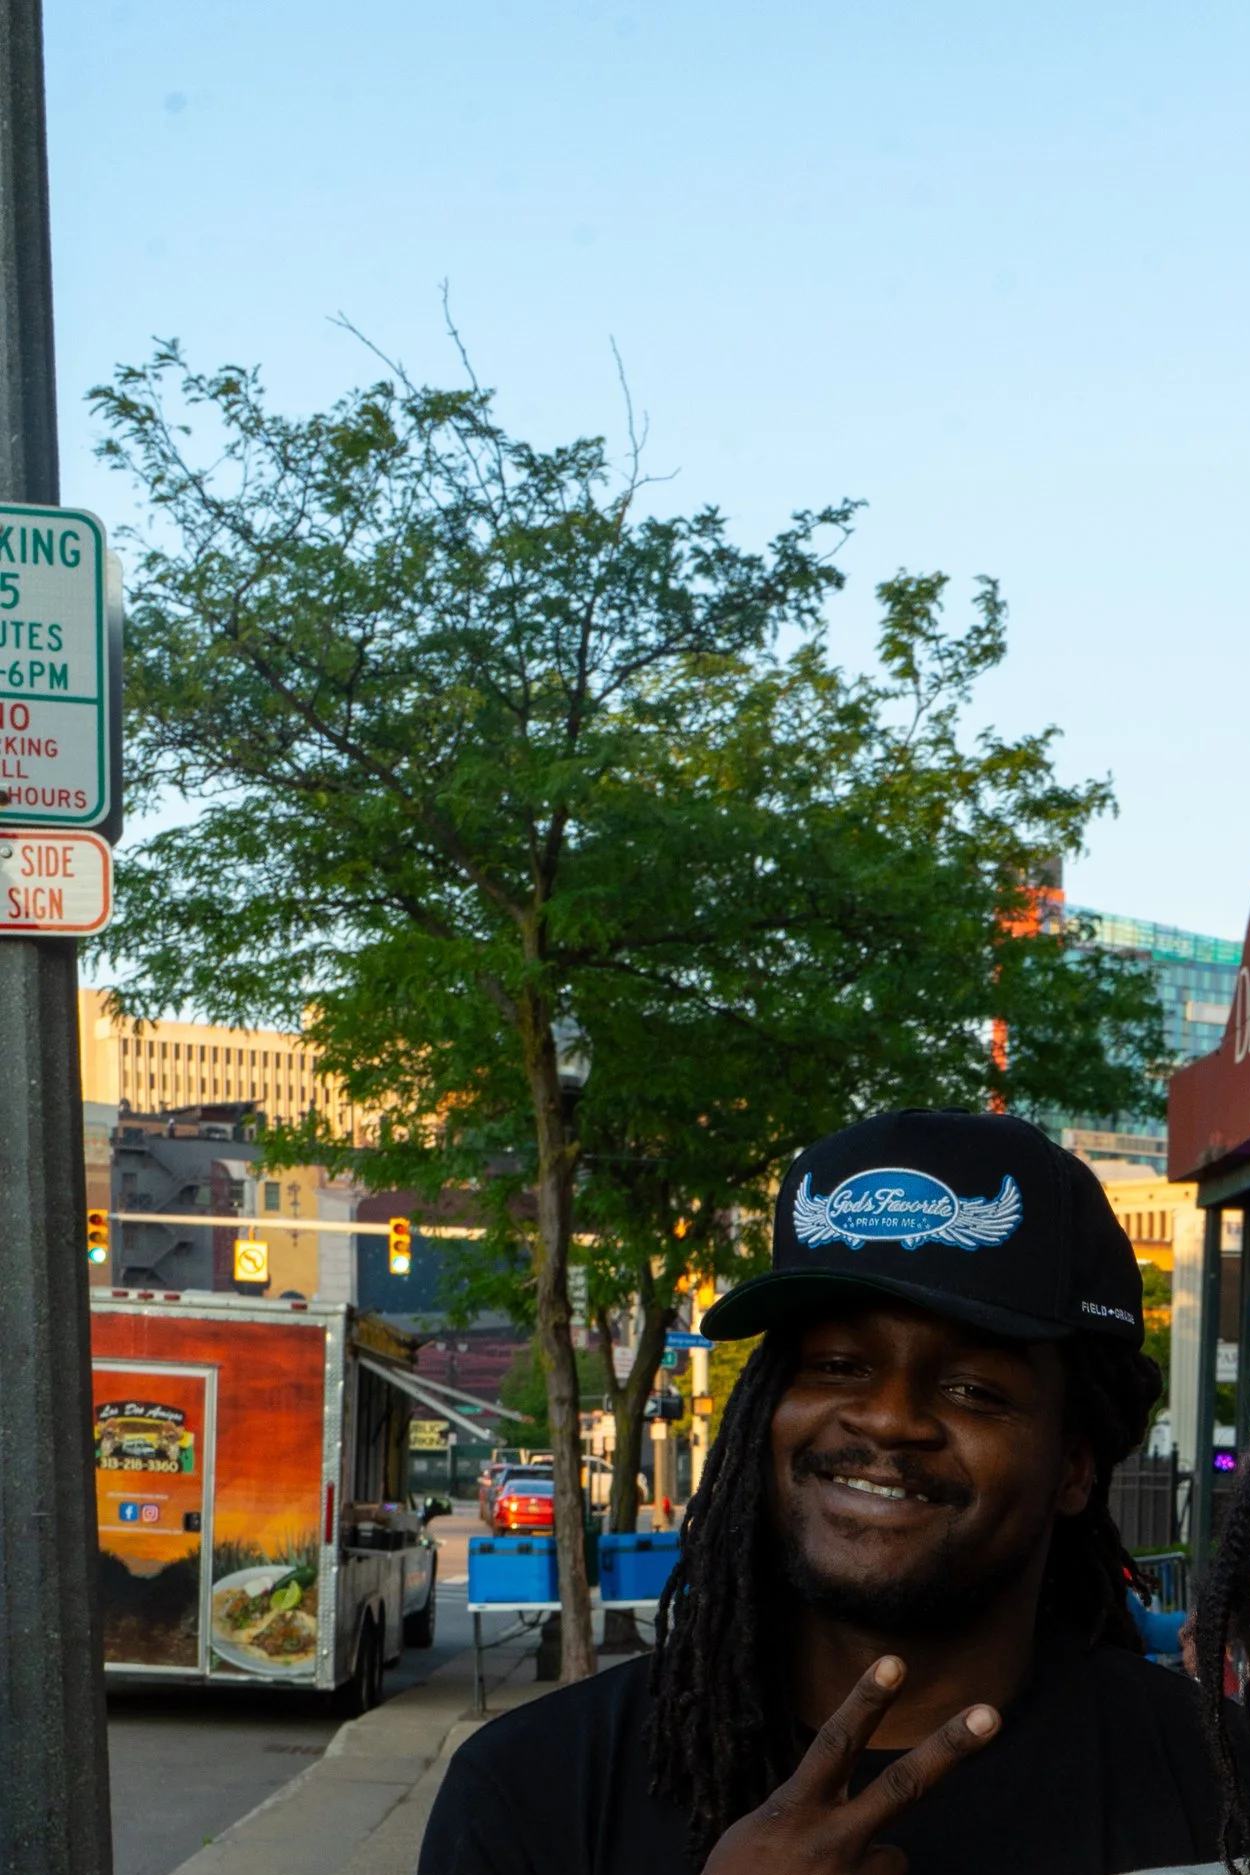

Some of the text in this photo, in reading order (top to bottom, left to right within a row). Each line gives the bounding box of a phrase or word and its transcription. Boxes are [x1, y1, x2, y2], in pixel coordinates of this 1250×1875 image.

[0, 736, 58, 757] KING
[8, 786, 87, 809] HOURS
[21, 845, 75, 878] SIDE
[8, 887, 63, 919] SIGN
[873, 1188, 952, 1217] Favorite
[855, 1218, 916, 1228] PRAY FOR ME
[1081, 1301, 1107, 1316] FIELD
